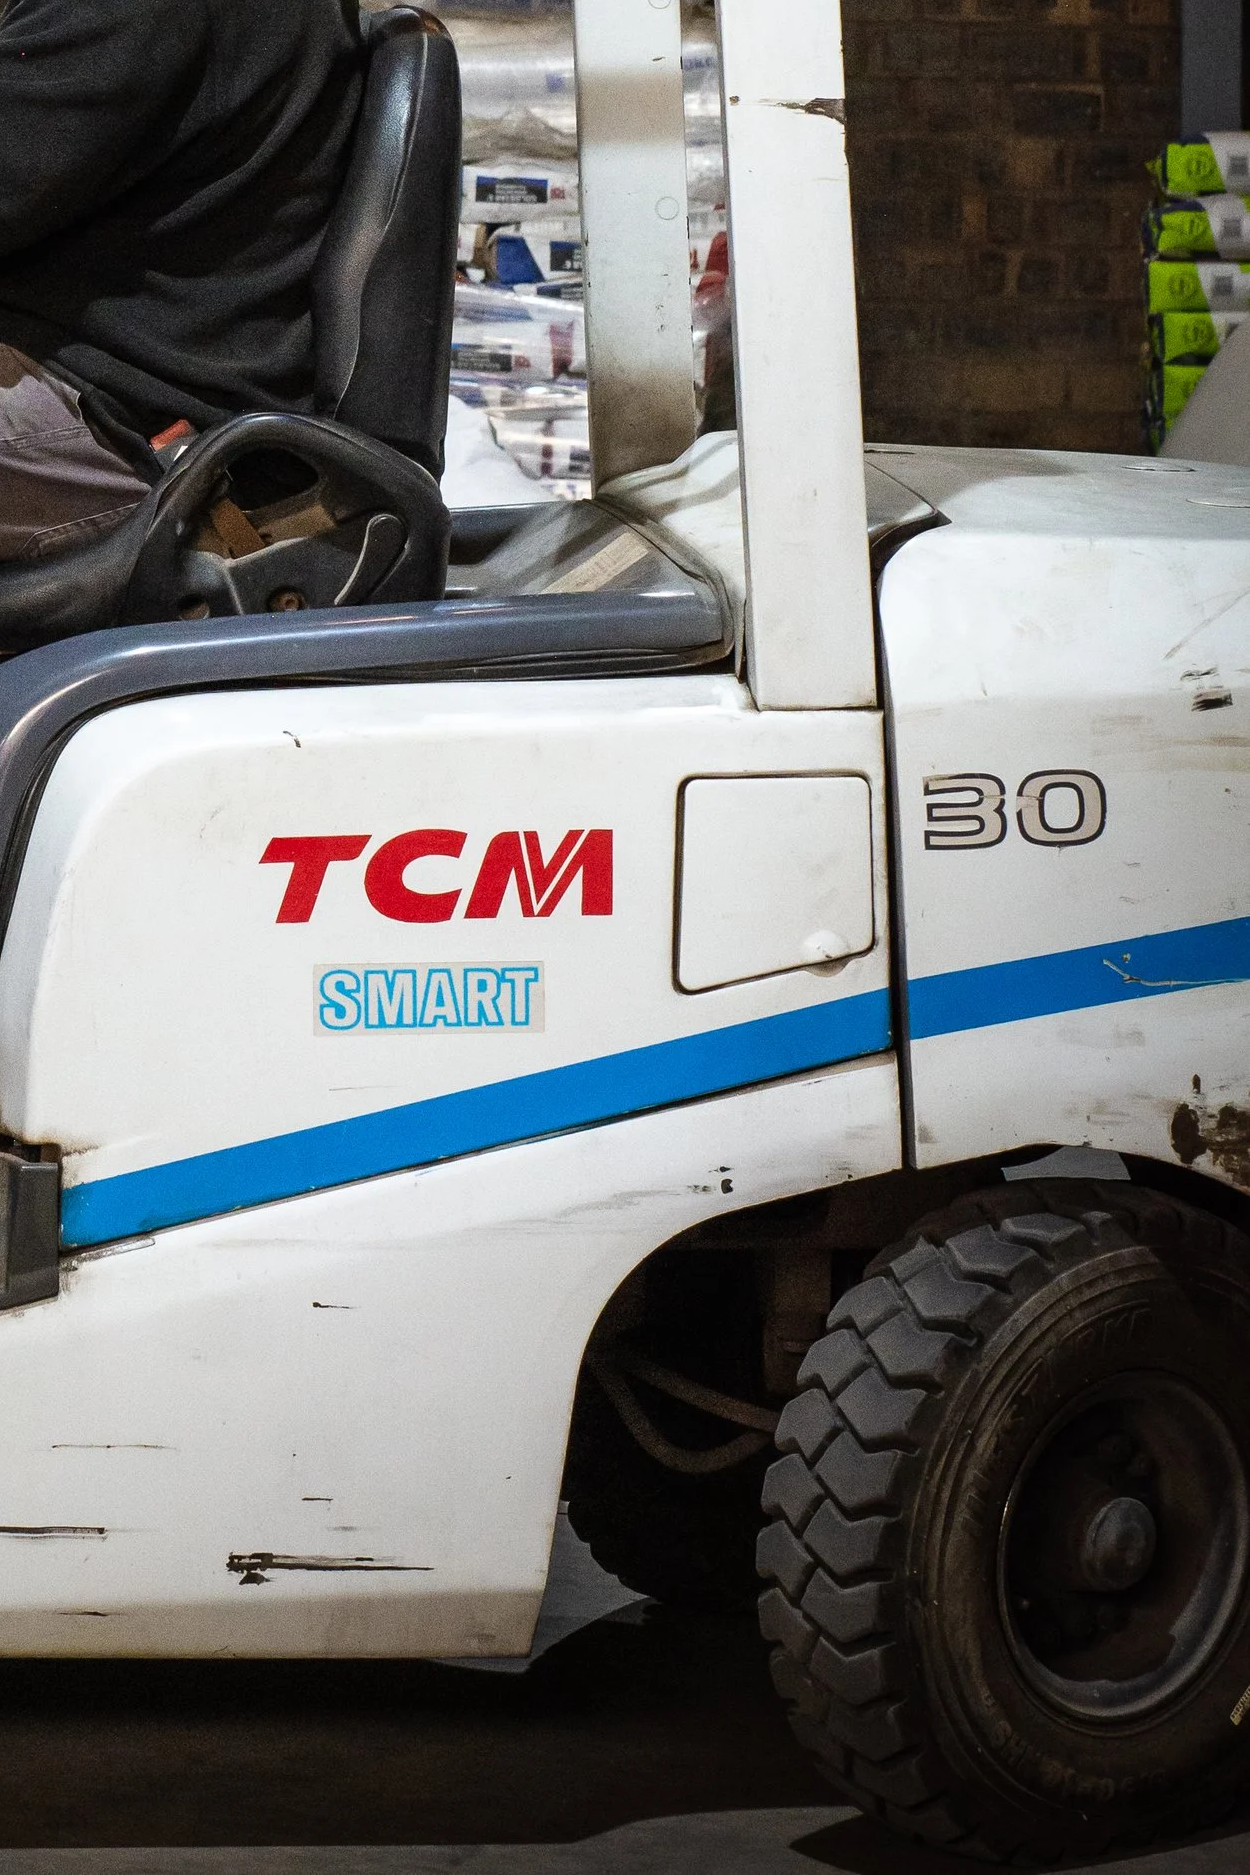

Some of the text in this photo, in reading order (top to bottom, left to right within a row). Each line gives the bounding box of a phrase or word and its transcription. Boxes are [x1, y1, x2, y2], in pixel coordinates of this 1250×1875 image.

[924, 769, 1107, 851] 30
[259, 828, 613, 923] TCM
[319, 969, 540, 1030] SMART
